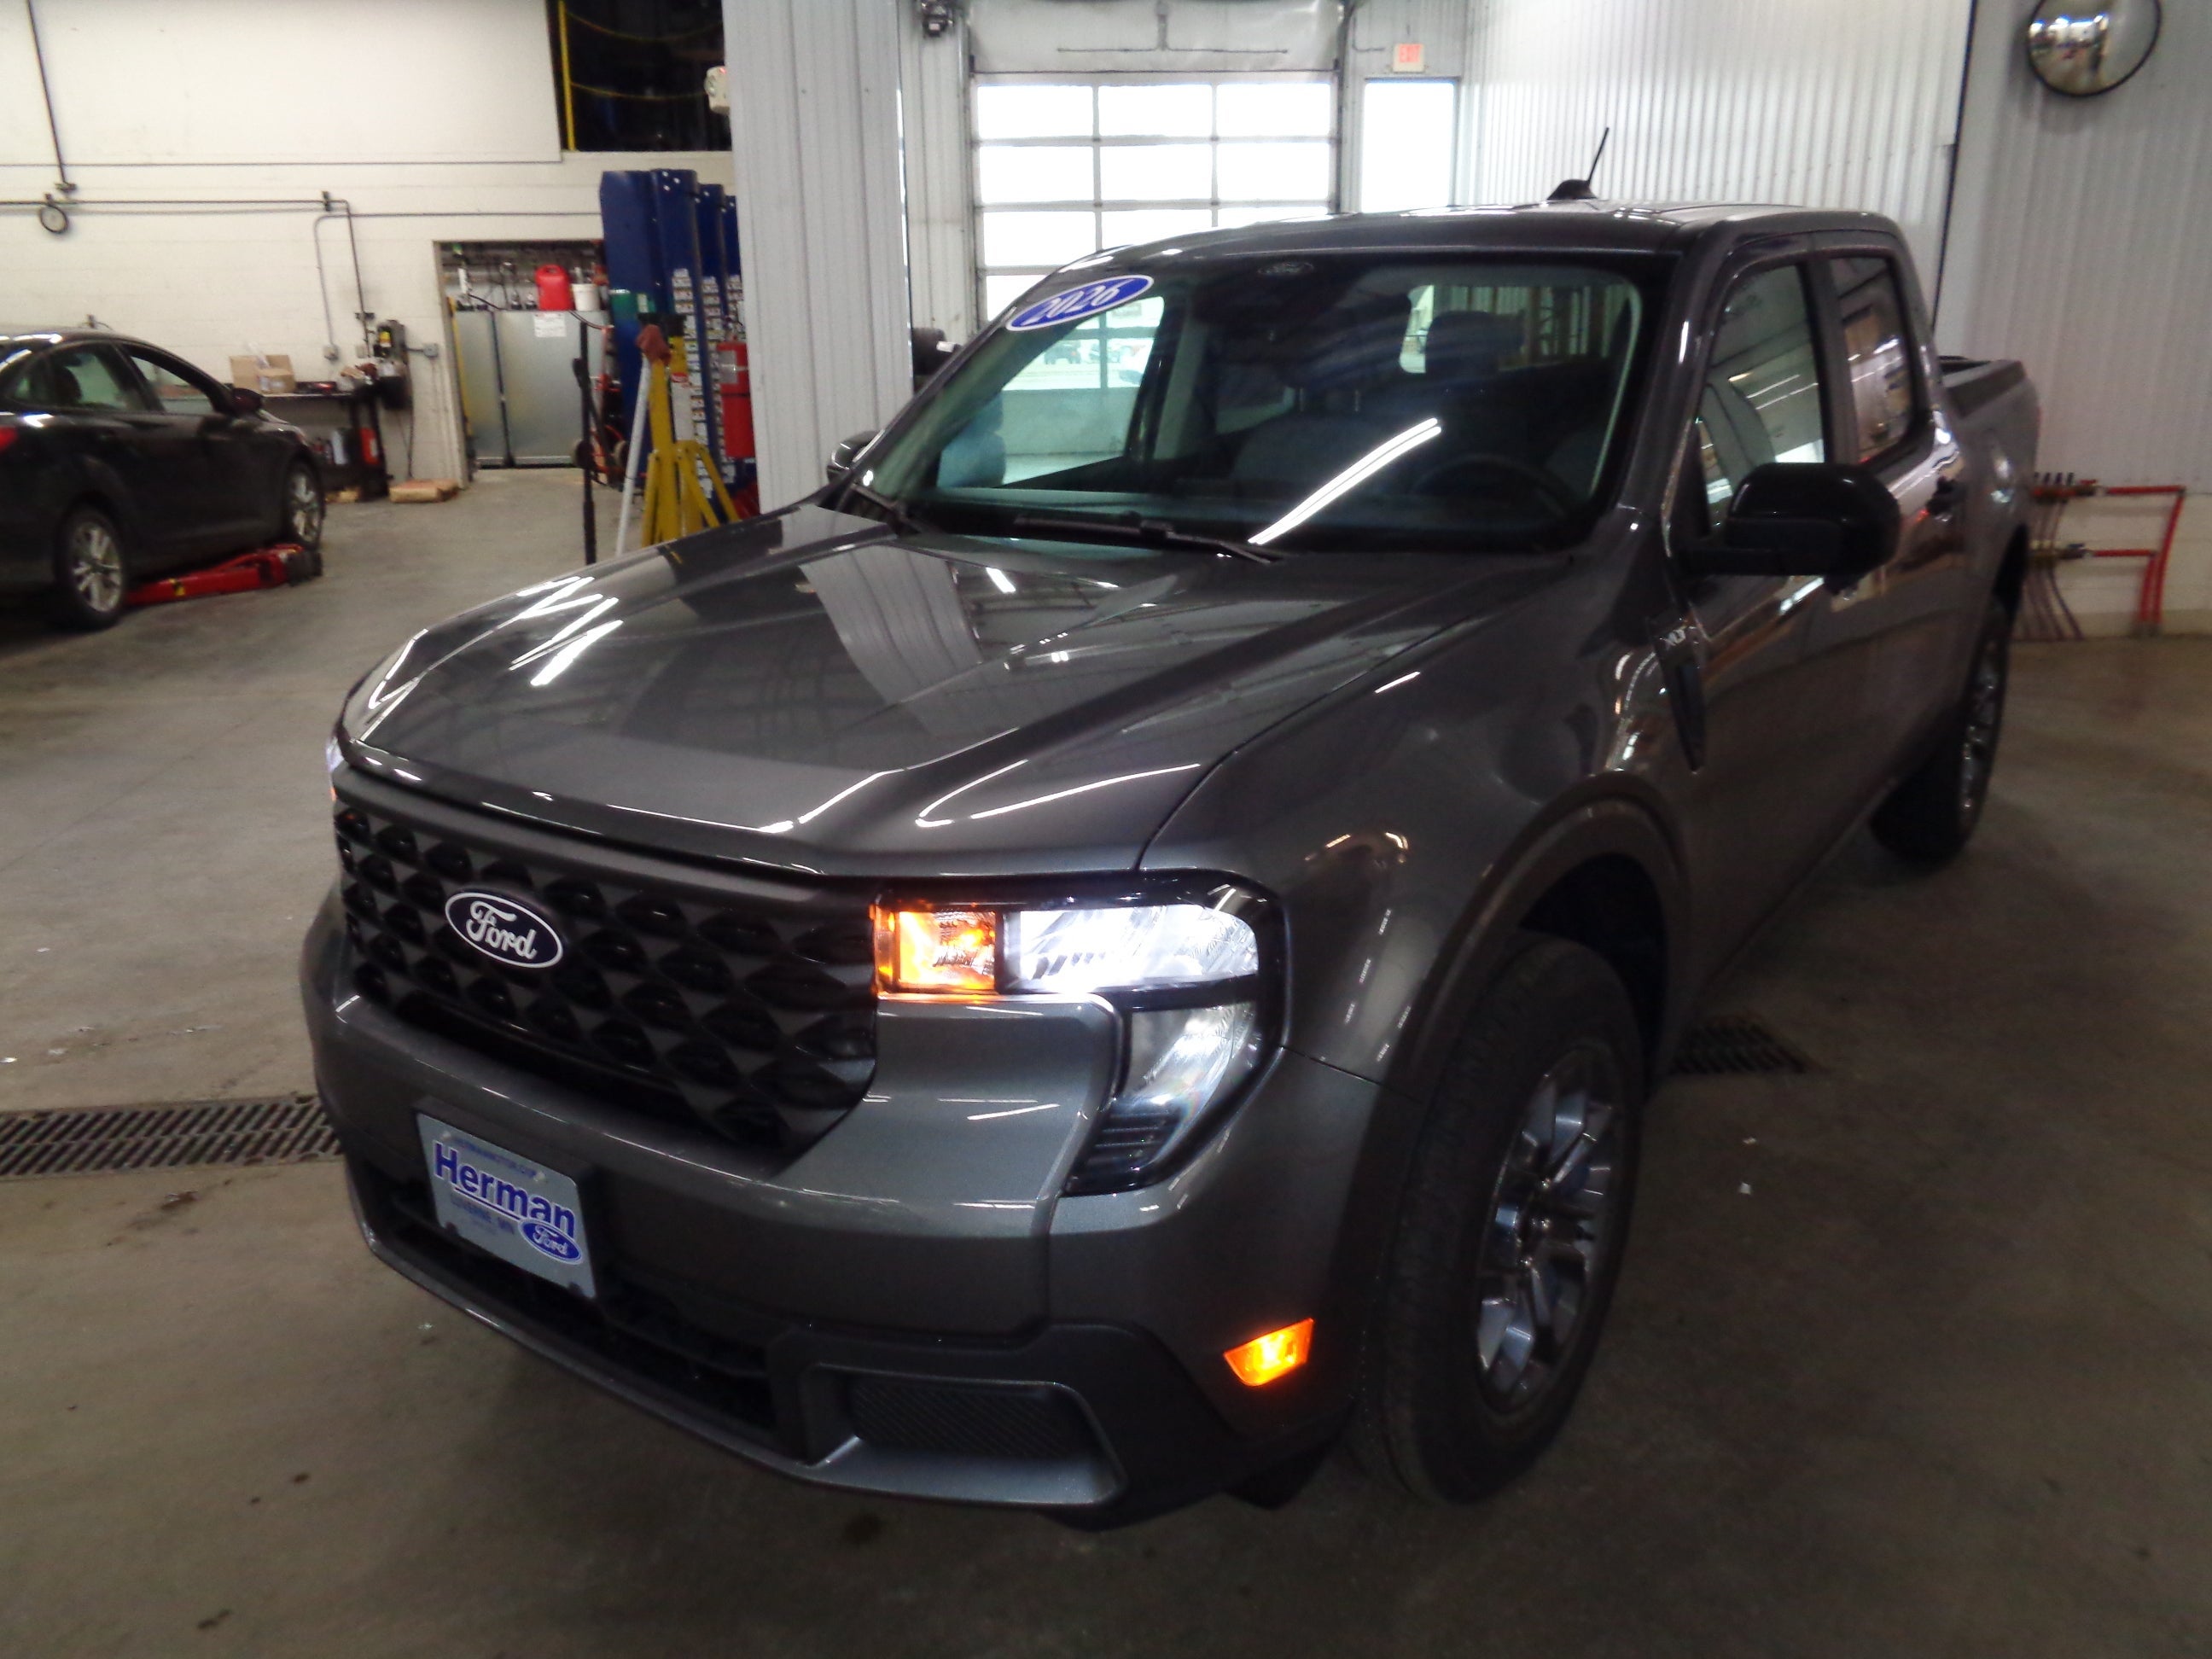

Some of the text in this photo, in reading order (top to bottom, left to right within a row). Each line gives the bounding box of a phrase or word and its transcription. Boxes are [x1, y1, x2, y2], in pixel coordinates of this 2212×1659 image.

[1021, 278, 1135, 326] 2026
[466, 900, 538, 959] Ford
[434, 1142, 575, 1239] Herman
[533, 1224, 569, 1255] Ford
